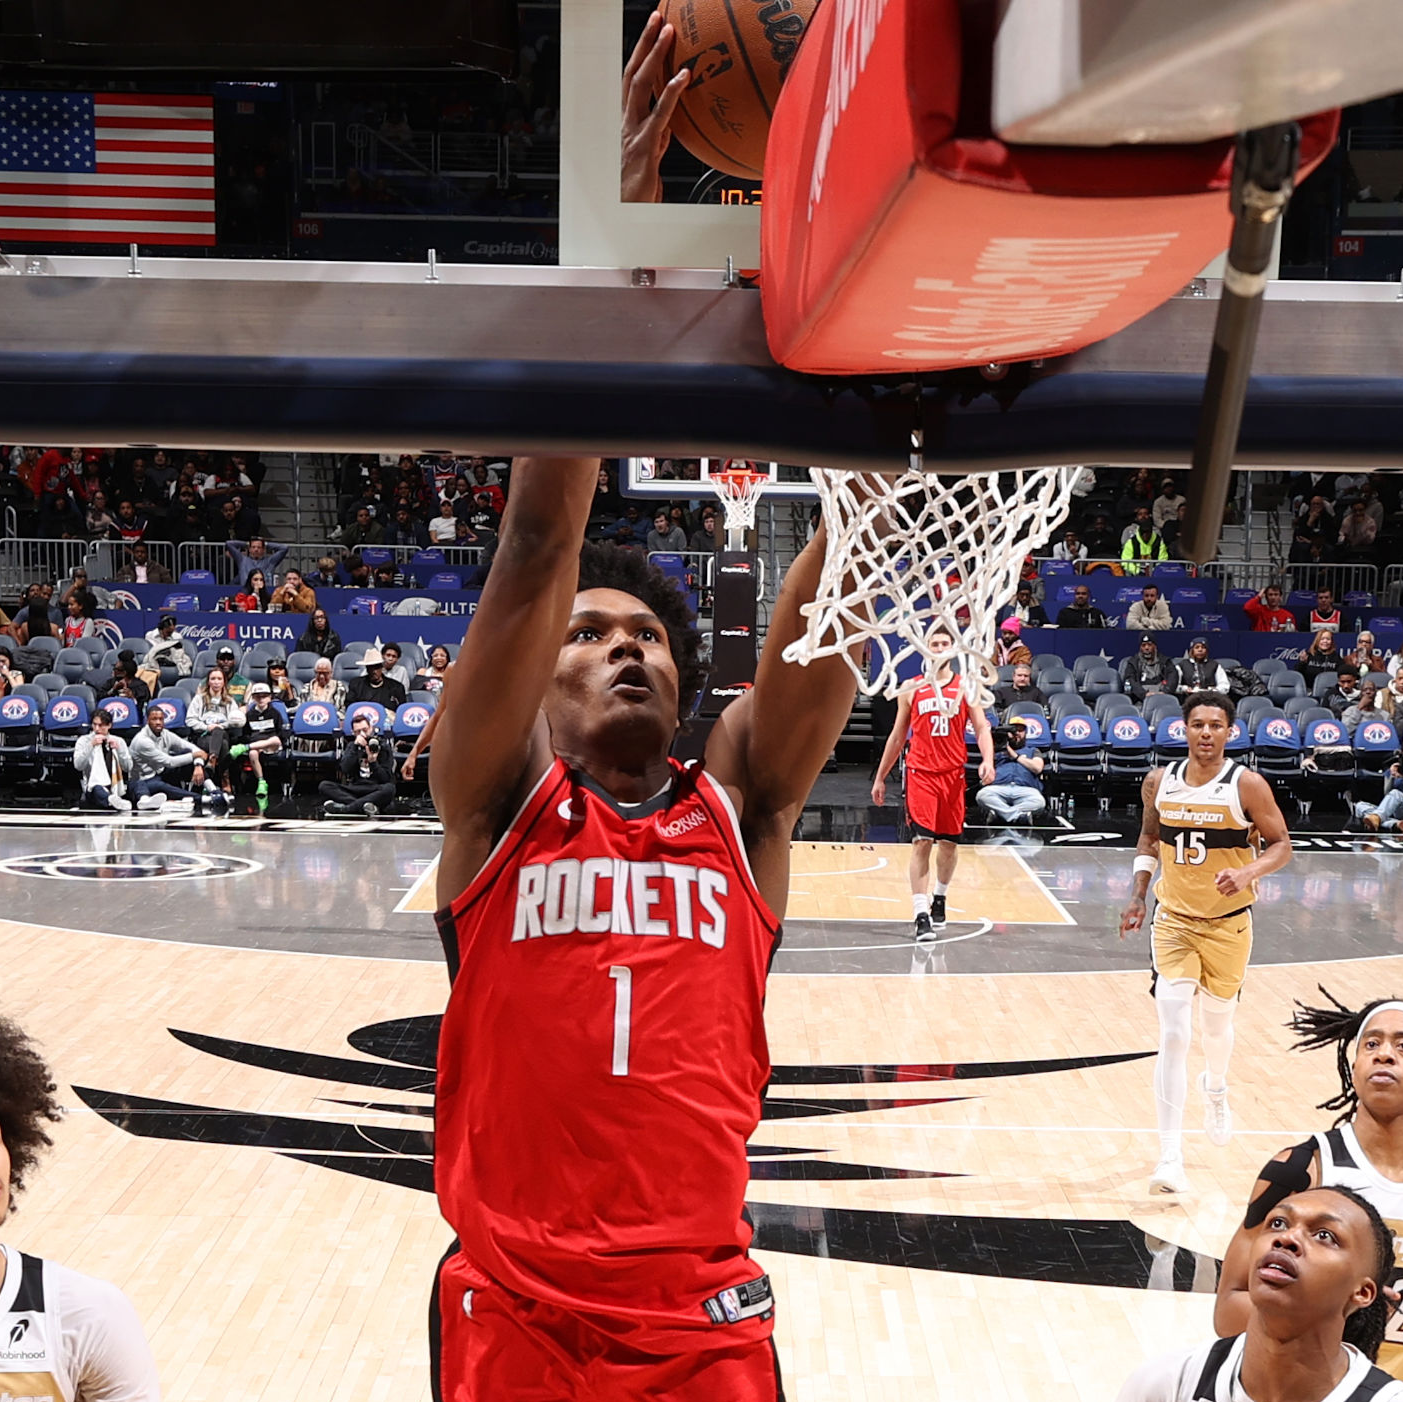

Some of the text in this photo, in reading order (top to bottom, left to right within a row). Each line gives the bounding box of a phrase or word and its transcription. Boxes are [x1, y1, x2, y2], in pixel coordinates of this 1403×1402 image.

[239, 626, 294, 639] ULTRA
[930, 714, 950, 737] 28
[1173, 831, 1208, 866] 15
[511, 856, 729, 950] ROCKETS
[609, 965, 632, 1076] 1
